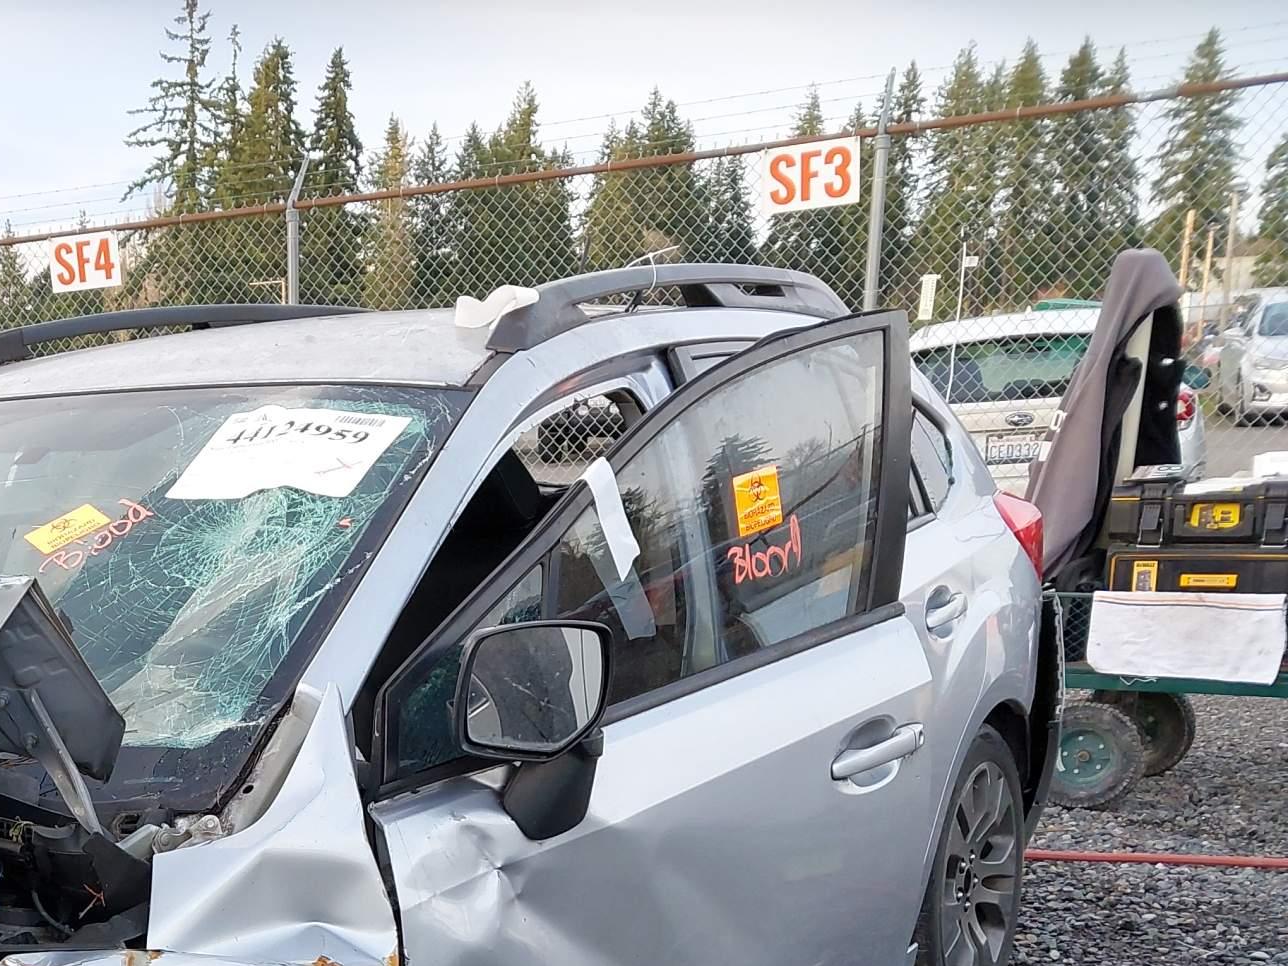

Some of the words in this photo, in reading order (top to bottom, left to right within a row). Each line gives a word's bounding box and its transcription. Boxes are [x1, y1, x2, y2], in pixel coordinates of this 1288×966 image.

[769, 146, 852, 205] SF3
[54, 237, 115, 286] SF4
[225, 419, 371, 445] 44124959
[989, 442, 1040, 459] CED332
